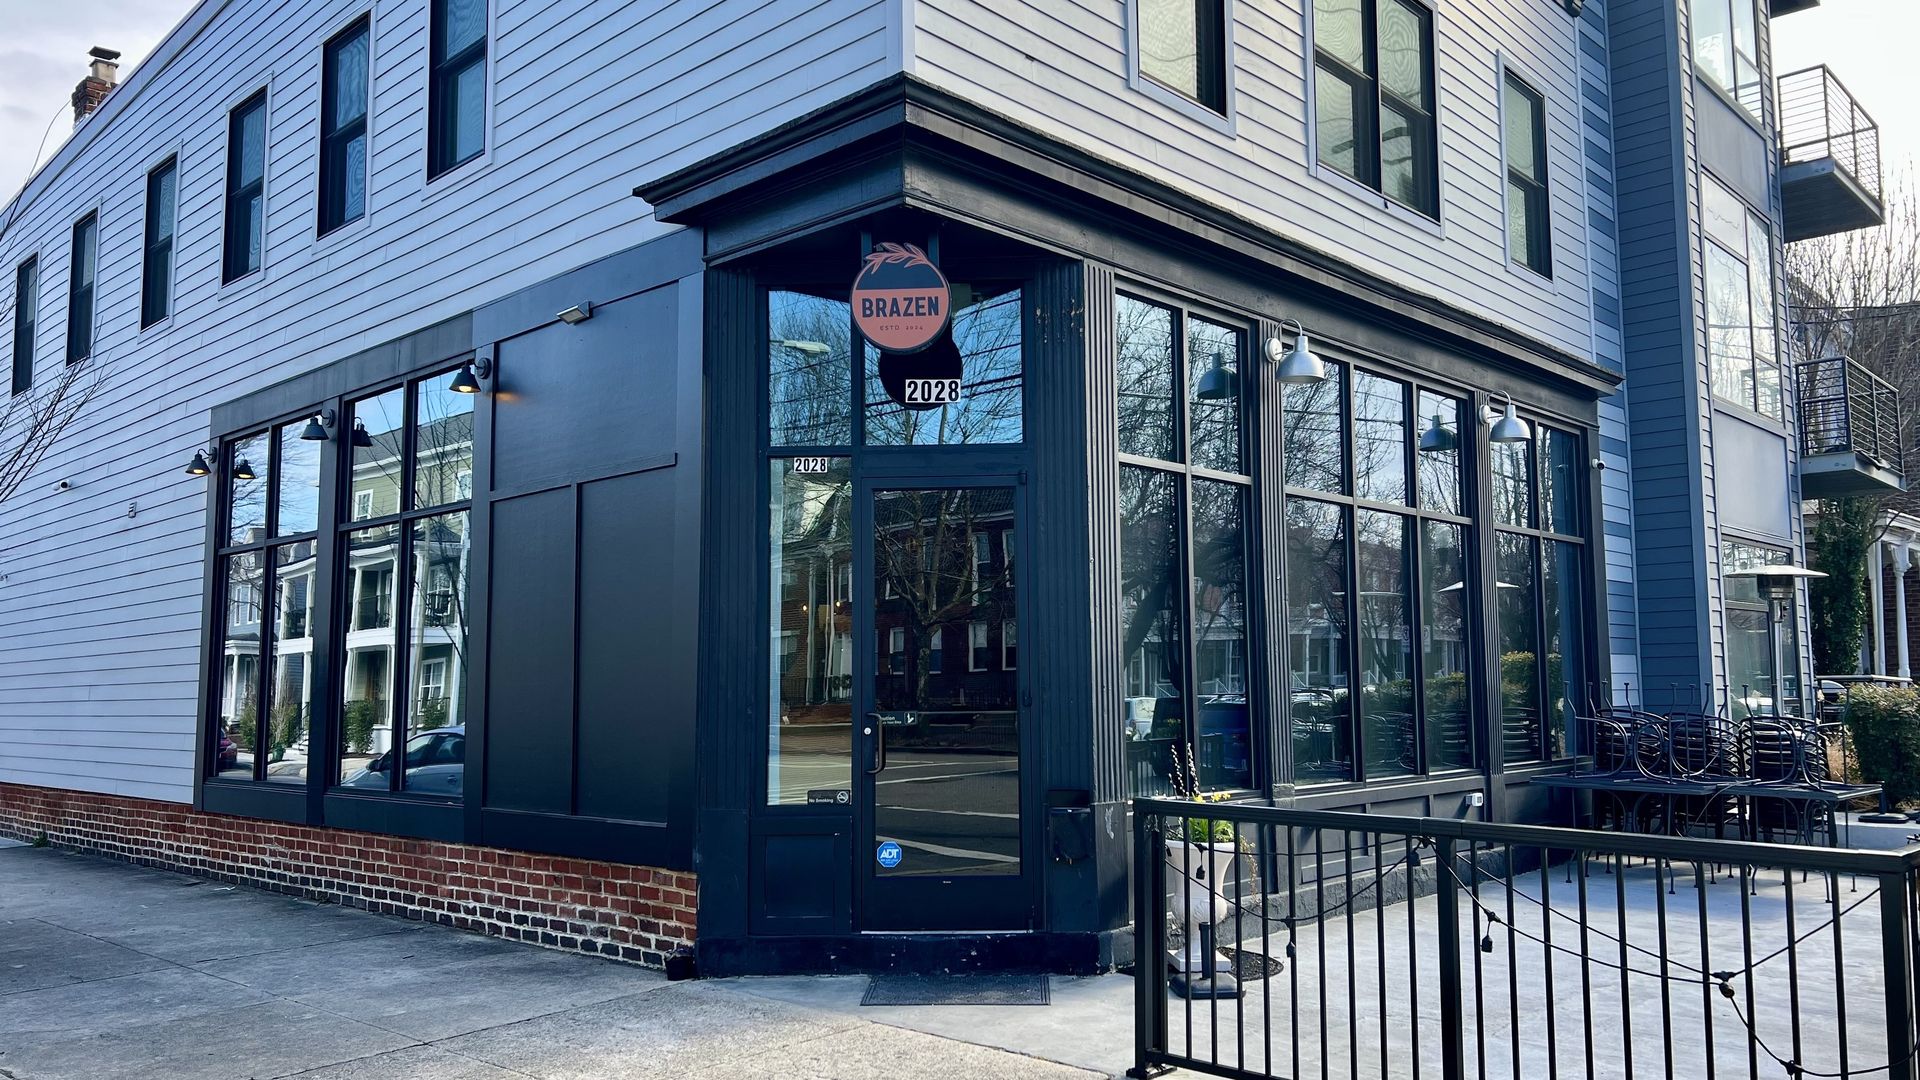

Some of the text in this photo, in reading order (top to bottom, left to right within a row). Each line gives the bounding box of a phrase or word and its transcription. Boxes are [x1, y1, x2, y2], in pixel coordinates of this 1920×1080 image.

[862, 296, 939, 318] BRAZEN
[907, 380, 960, 402] 2028
[794, 458, 826, 472] 2028
[880, 848, 899, 859] ADT
